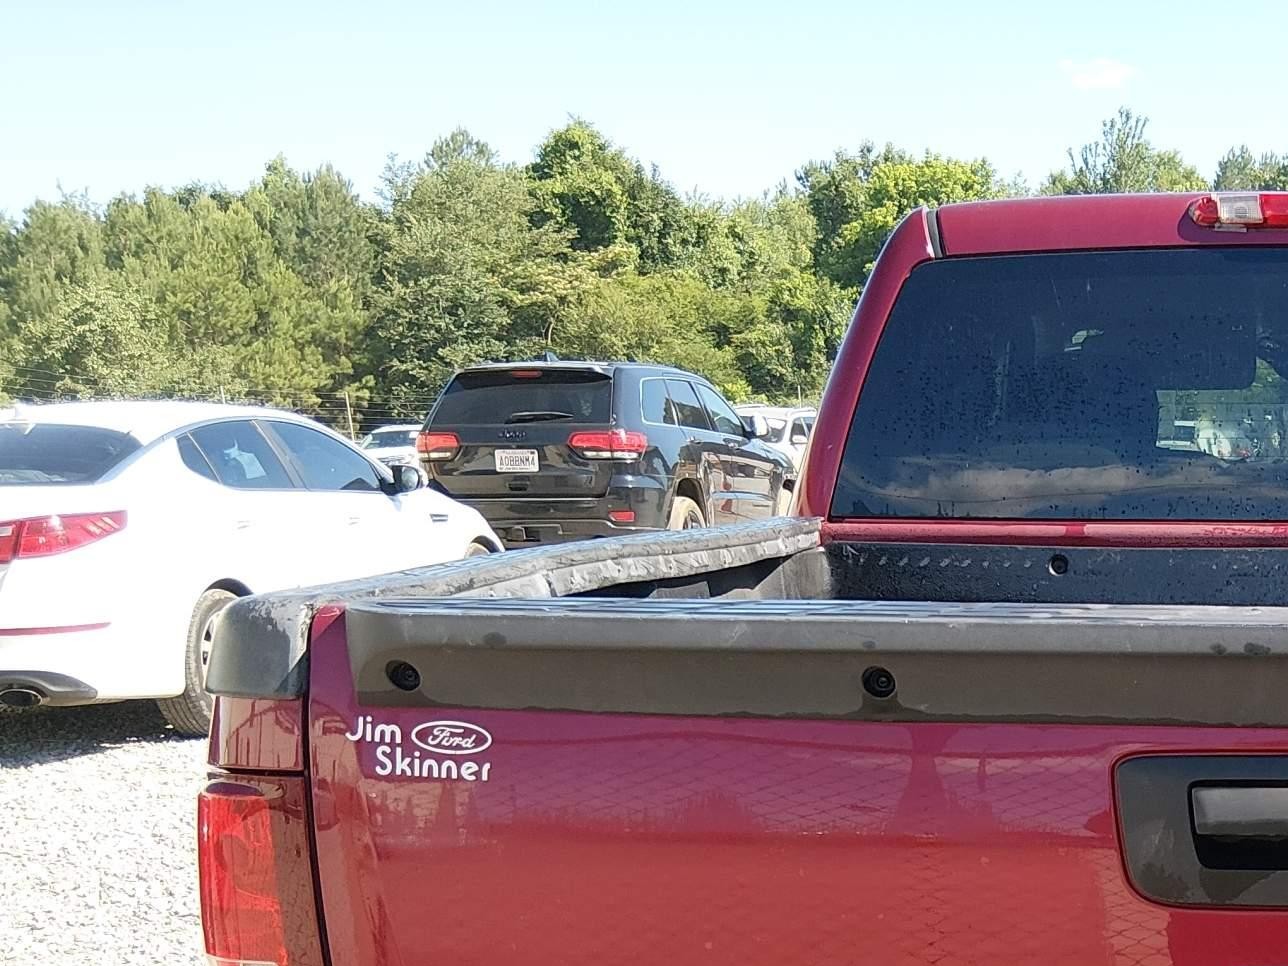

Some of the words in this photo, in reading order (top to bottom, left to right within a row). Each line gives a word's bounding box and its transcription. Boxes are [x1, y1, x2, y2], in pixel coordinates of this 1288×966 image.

[345, 715, 402, 744] Jim
[427, 726, 477, 749] Ford
[375, 745, 491, 781] Skinner
